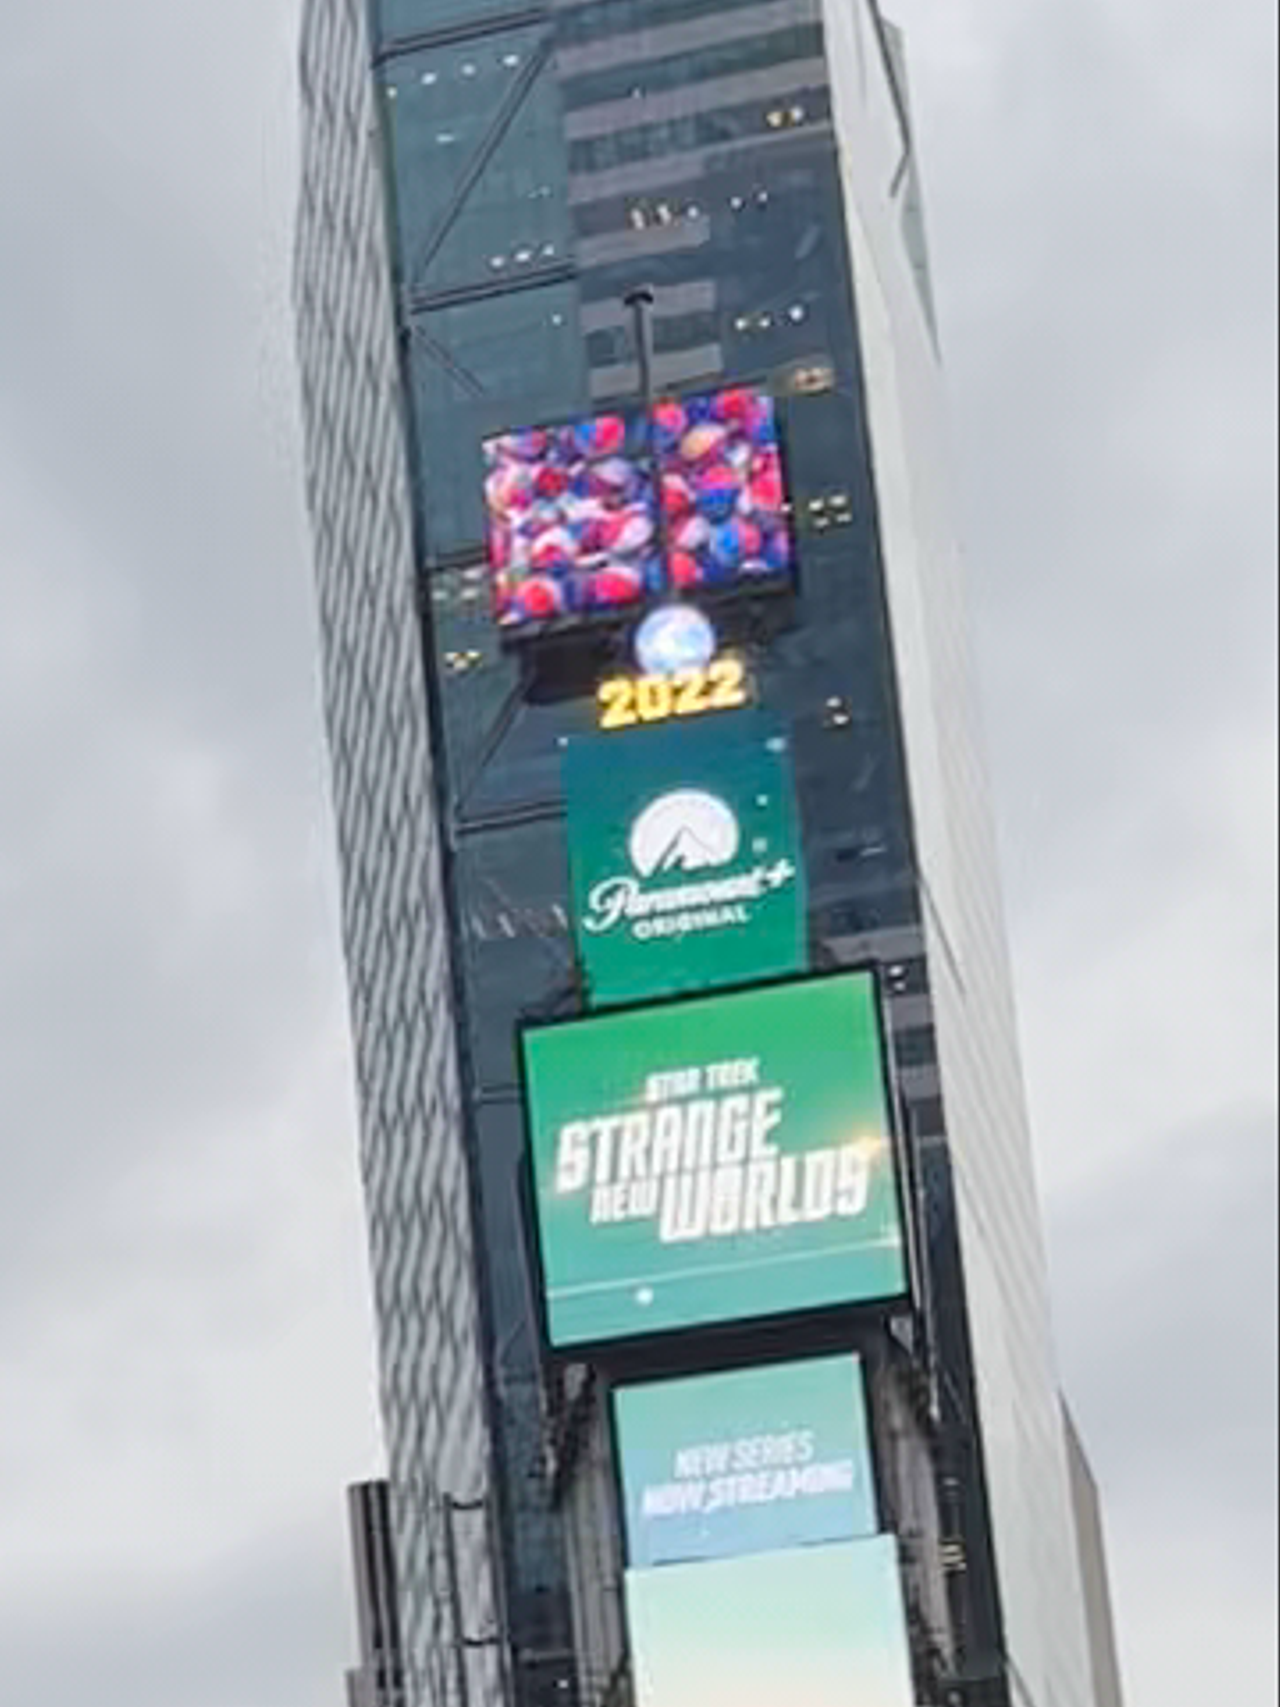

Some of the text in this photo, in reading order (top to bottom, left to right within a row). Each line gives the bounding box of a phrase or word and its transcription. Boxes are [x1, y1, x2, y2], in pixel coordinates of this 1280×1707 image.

[597, 659, 746, 729] 2022
[632, 904, 751, 940] ORIGINAL
[646, 1057, 759, 1102] STAR TREK
[556, 1087, 783, 1195] STRANGE
[658, 1145, 873, 1243] WORLDS
[673, 1429, 816, 1479] NEW SERIES
